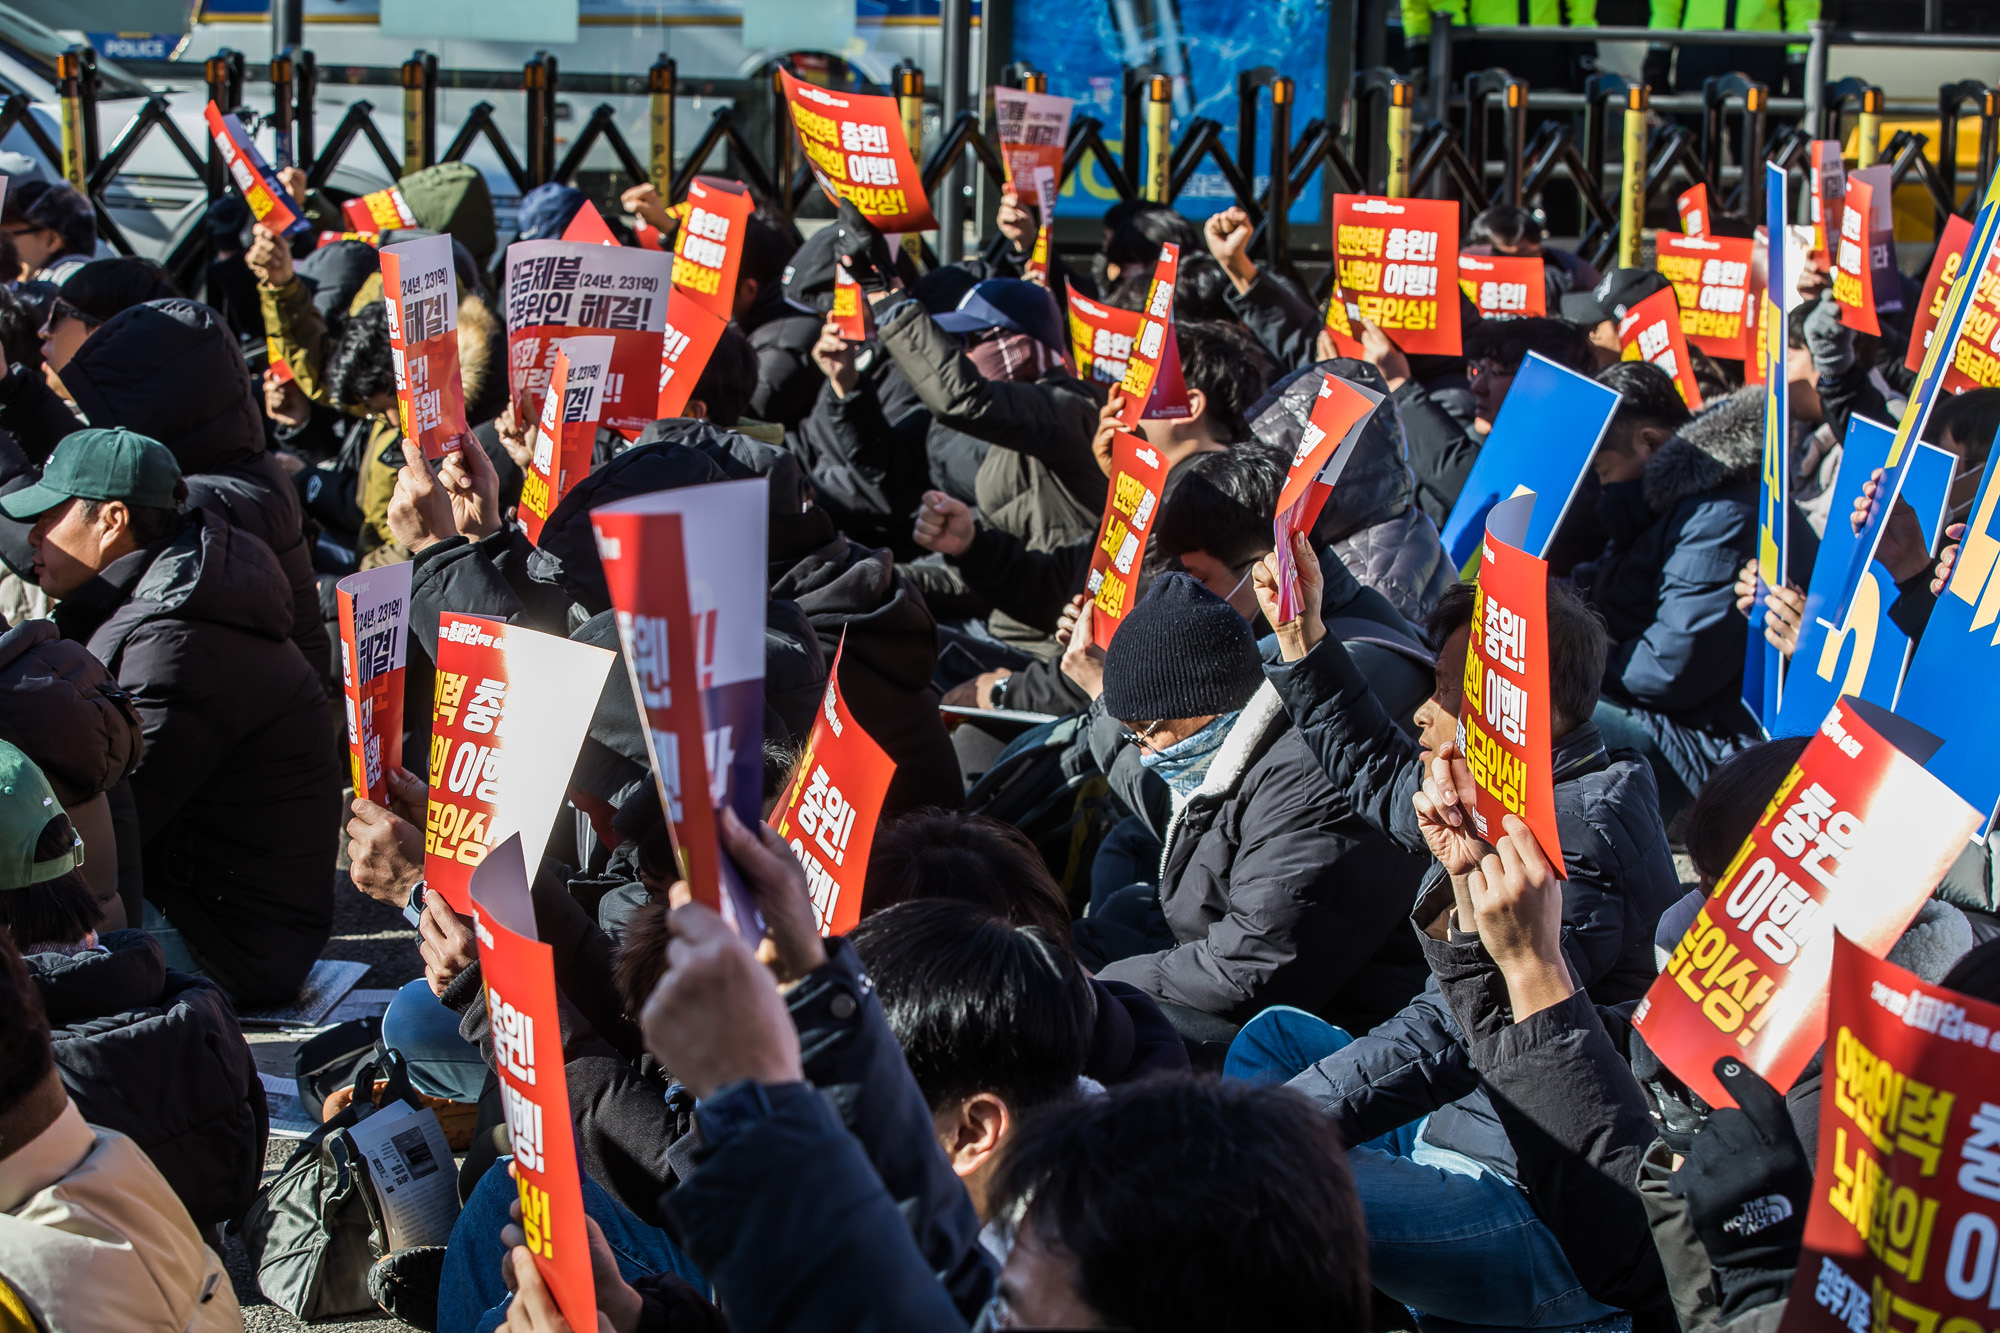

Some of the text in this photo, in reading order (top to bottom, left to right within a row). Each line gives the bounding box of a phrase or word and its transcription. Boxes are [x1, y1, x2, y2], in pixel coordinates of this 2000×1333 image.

[104, 40, 165, 58] POLICE
[841, 121, 890, 153] 충원!
[848, 154, 899, 185] 이행!
[1386, 228, 1438, 261] 충원!
[424, 267, 449, 291] 231억)
[619, 275, 659, 292] 231억)
[1383, 263, 1438, 296] 이행!
[1480, 281, 1527, 310] 충원!
[403, 292, 449, 345] 해결!
[578, 294, 653, 331] 해결!
[564, 386, 595, 424] 결!
[377, 597, 403, 625] 231억)
[1485, 595, 1526, 675] 충원!
[360, 625, 399, 687] 해결!
[433, 668, 470, 727] 인력
[1485, 668, 1528, 748] 이행!
[1466, 713, 1527, 819] 임금인상!
[798, 764, 857, 867] 충원!
[1771, 782, 1864, 894] 충원
[1725, 856, 1822, 965] 이행
[1667, 907, 1778, 1048] 금인상!
[1740, 1198, 1766, 1214] THE
[1739, 1216, 1770, 1237] FACE
